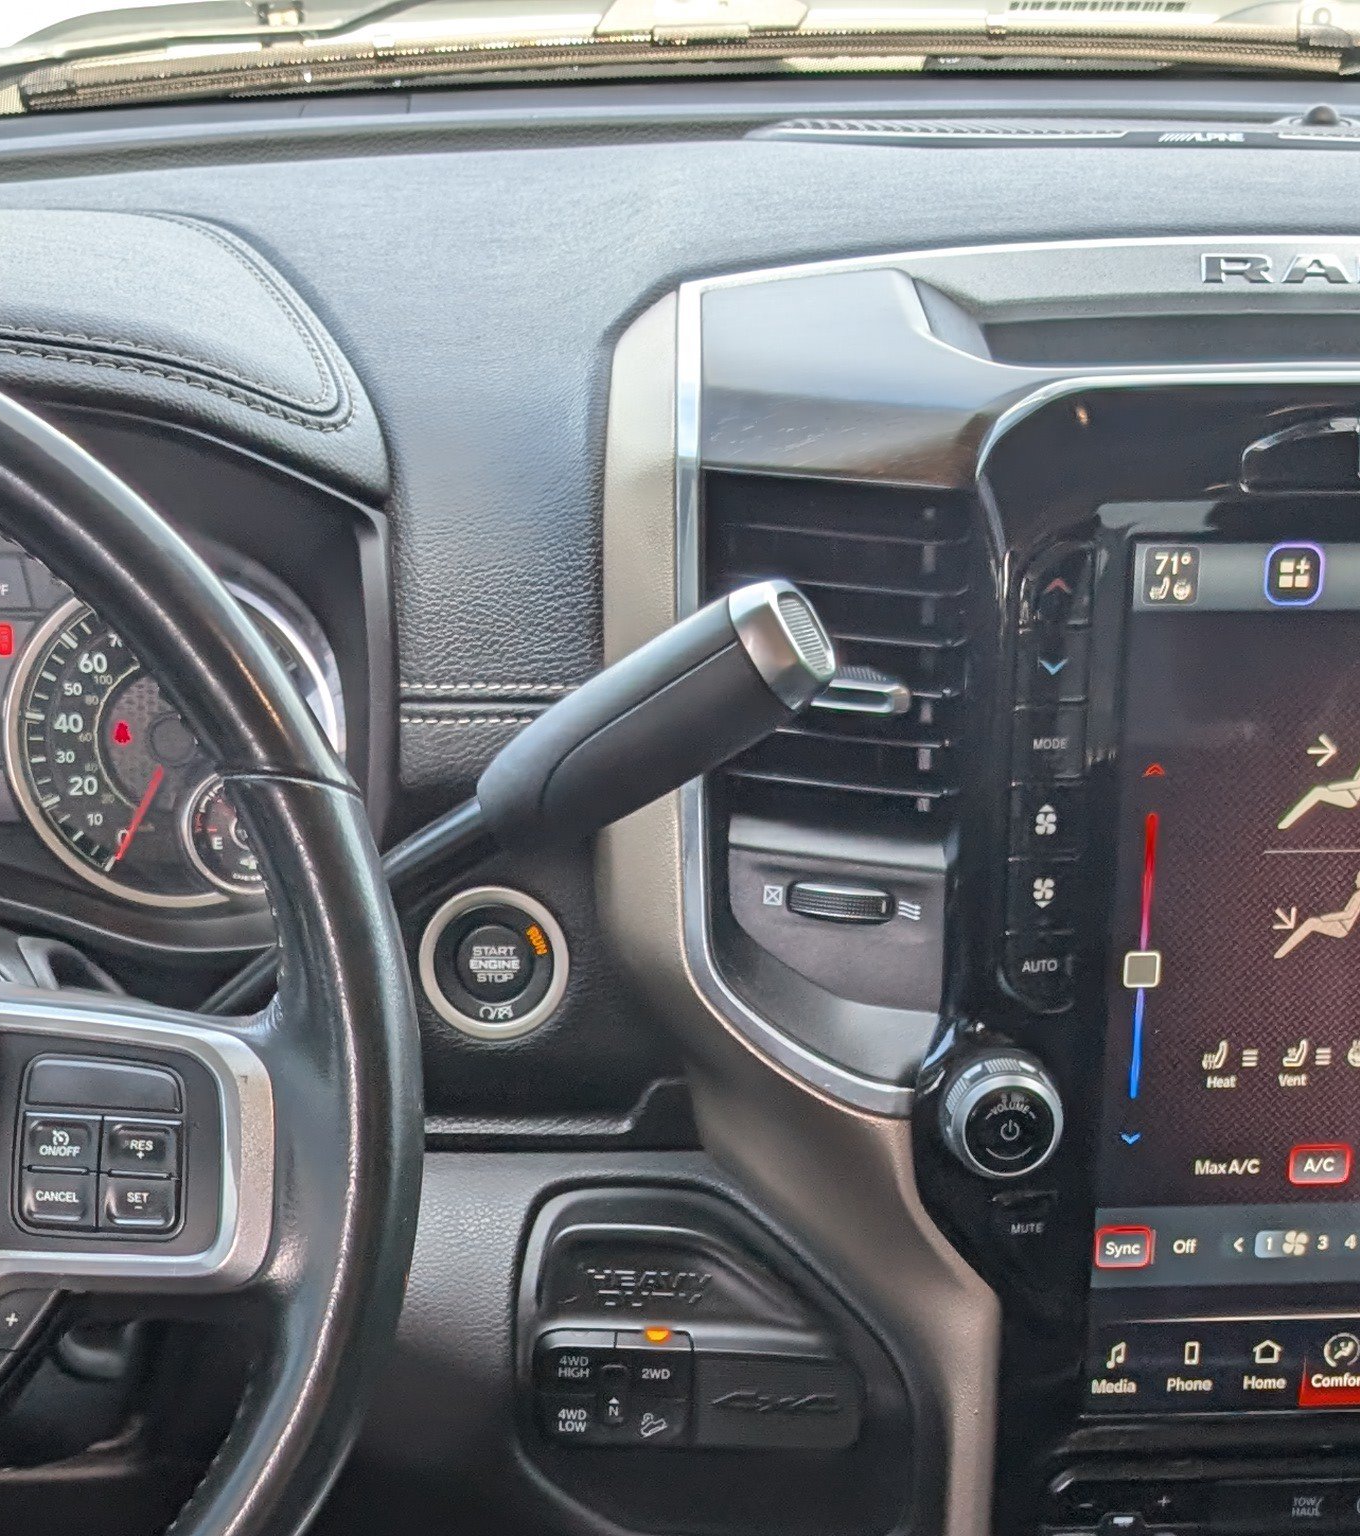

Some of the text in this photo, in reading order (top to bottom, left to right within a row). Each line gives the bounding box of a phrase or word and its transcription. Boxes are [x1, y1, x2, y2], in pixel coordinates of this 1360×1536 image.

[1154, 552, 1192, 575] 71°
[79, 653, 108, 675] 60
[63, 682, 83, 696] 50
[54, 713, 84, 734] 40
[1033, 738, 1069, 750] MODE
[55, 750, 75, 764] 30
[69, 776, 99, 797] 20
[87, 813, 103, 826] 10
[212, 836, 224, 850] E
[525, 923, 548, 956] RUN
[472, 945, 517, 957] START
[469, 959, 521, 970] ENGINE
[1022, 959, 1058, 973] AUTO
[477, 972, 515, 983] STOP
[1206, 1075, 1236, 1089] Heat
[1279, 1074, 1307, 1087] Vent
[990, 1100, 1030, 1115] VOLUME
[39, 1143, 80, 1158] ON/OFF
[130, 1138, 154, 1151] RES
[1195, 1158, 1261, 1176] Max A/C
[1303, 1157, 1336, 1173] A/C
[35, 1190, 79, 1204] CANCEL
[126, 1191, 150, 1204] SET
[1011, 1222, 1046, 1234] MUTE
[1105, 1241, 1140, 1259] Sync
[1173, 1238, 1198, 1255] Off
[1265, 1235, 1275, 1251] 1
[1318, 1235, 1330, 1251] 3
[1344, 1235, 1357, 1250] 4
[558, 1355, 589, 1367] 4WD
[557, 1367, 590, 1379] HIGH
[642, 1368, 671, 1380] 2WD
[1092, 1377, 1137, 1395] Media
[1166, 1376, 1212, 1393] Phone
[1243, 1374, 1287, 1391] Home
[558, 1408, 587, 1421] 4WD
[608, 1404, 619, 1417] N
[558, 1420, 586, 1432] LOW
